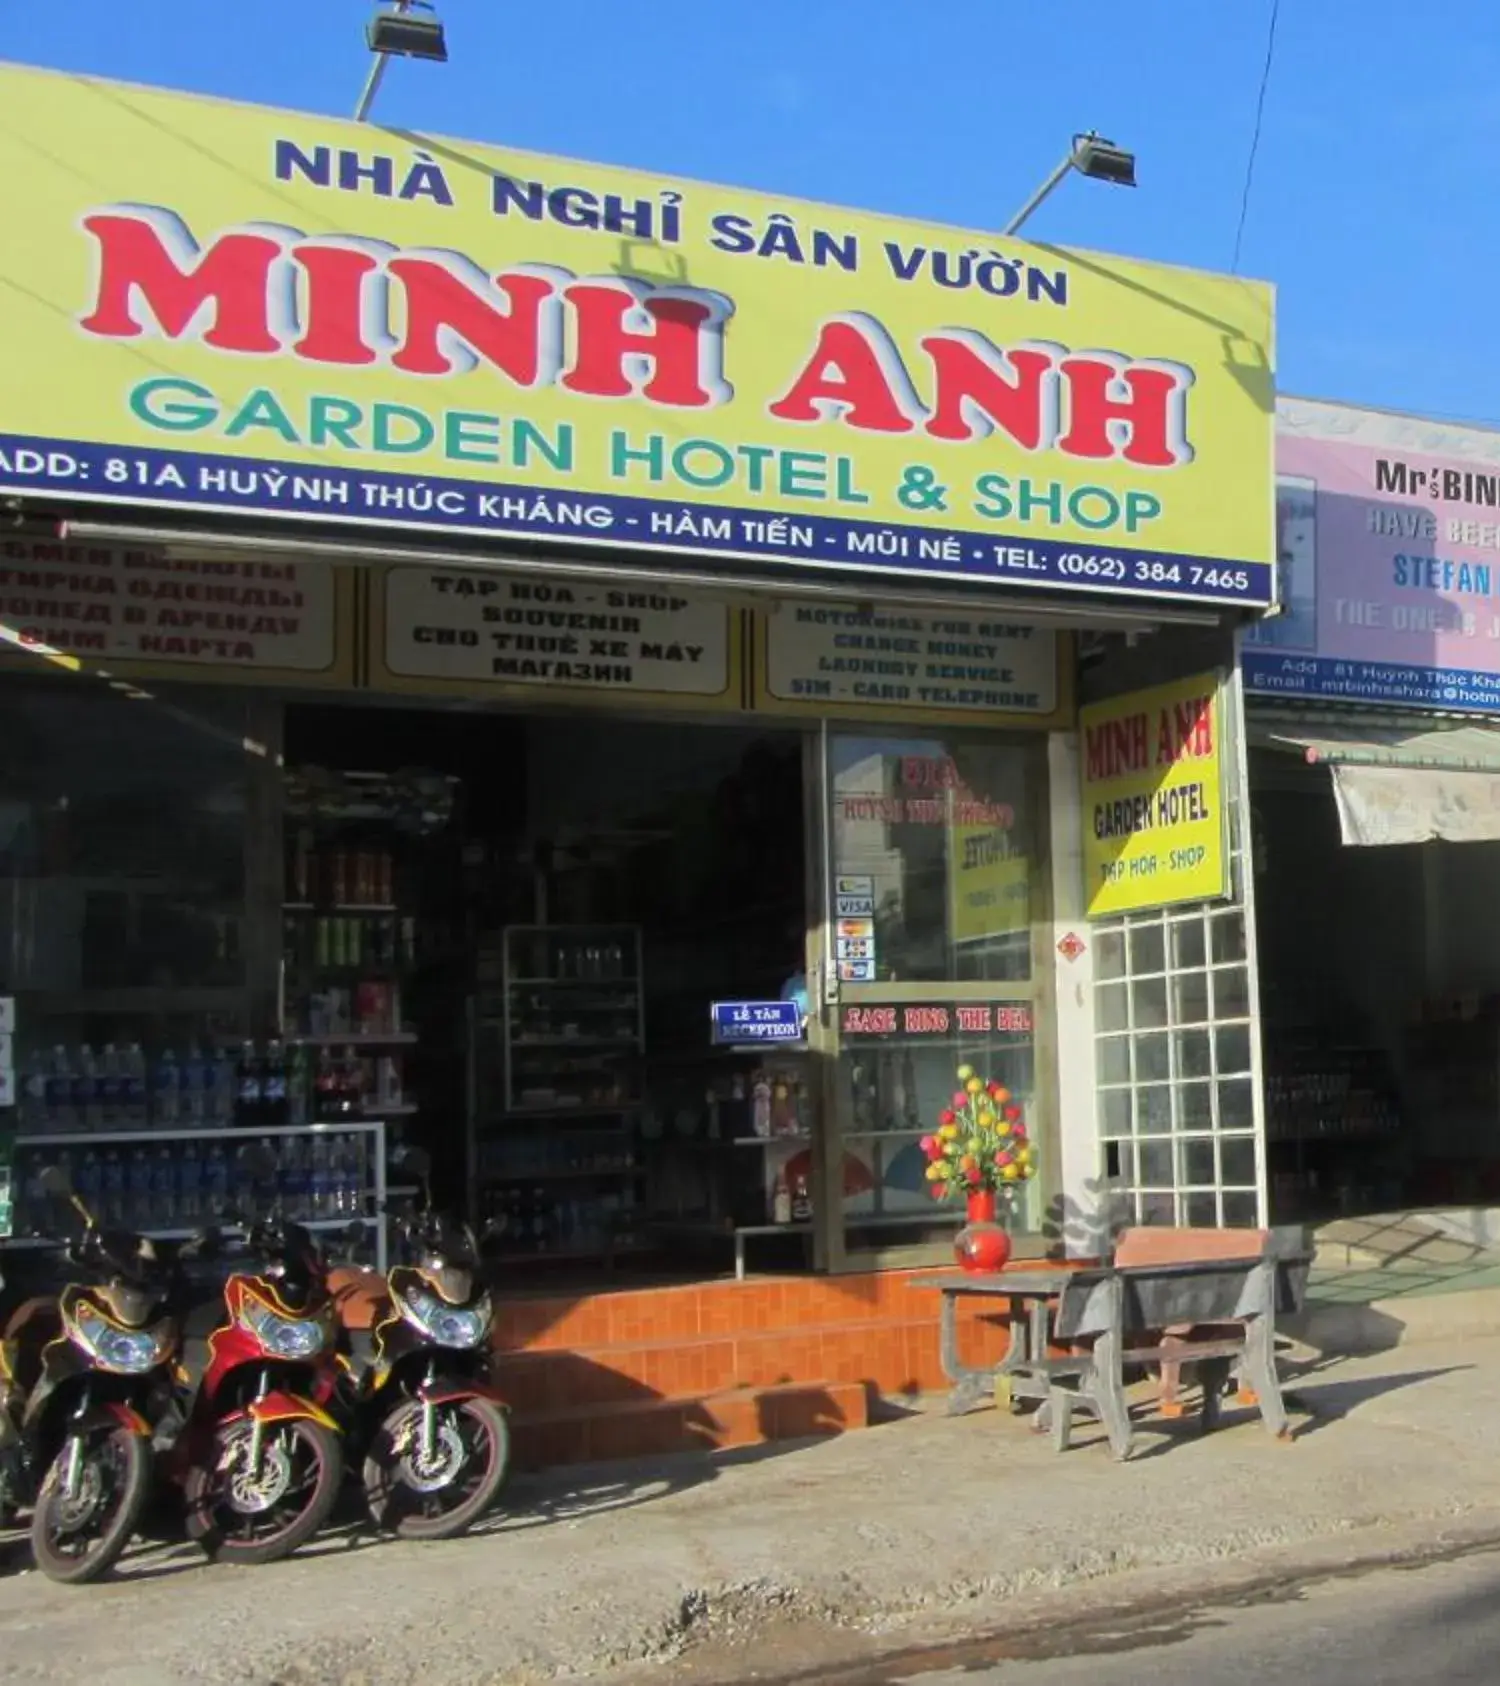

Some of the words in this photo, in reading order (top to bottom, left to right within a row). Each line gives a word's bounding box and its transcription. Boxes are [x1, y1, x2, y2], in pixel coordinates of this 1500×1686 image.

[275, 139, 455, 206] NHÀ
[492, 175, 683, 243] NGHỈ
[710, 213, 858, 271] SÂN
[884, 242, 1068, 306] VƯỜN
[80, 205, 733, 407] MINH
[769, 314, 1194, 467] ANH
[129, 378, 573, 472] GARDEN
[611, 431, 869, 505] HOTEL
[898, 465, 948, 512] &
[974, 473, 1161, 533] SHOP
[0, 449, 90, 479] ADD:
[104, 458, 186, 488] 81A
[199, 463, 348, 505] HUỲNH
[361, 469, 467, 516] THÚC
[478, 485, 614, 529] KHÁNG
[650, 504, 731, 541] HÀM
[743, 516, 814, 549] TIẾN
[847, 527, 909, 558] MŨI
[918, 533, 962, 563] NÉ
[994, 546, 1048, 573] TEL:
[1057, 553, 1126, 583] (062)
[1135, 561, 1182, 587] 384
[1189, 565, 1249, 592] 7465
[1367, 506, 1437, 541] HAVE
[1393, 553, 1490, 596] STEFAN
[606, 589, 688, 612] SHOP
[1334, 596, 1382, 628] THE
[1391, 603, 1446, 633] ONE
[482, 605, 642, 633] SOUVENIR
[590, 638, 630, 658] XE
[1253, 673, 1307, 690] Email
[1085, 711, 1149, 783] MINH
[1157, 695, 1213, 766] ANH
[1094, 791, 1154, 841] GARDEN
[1158, 782, 1209, 829] HOTEL
[1169, 845, 1206, 871] SHOP
[839, 900, 873, 914] VISA
[956, 1008, 991, 1032] THE
